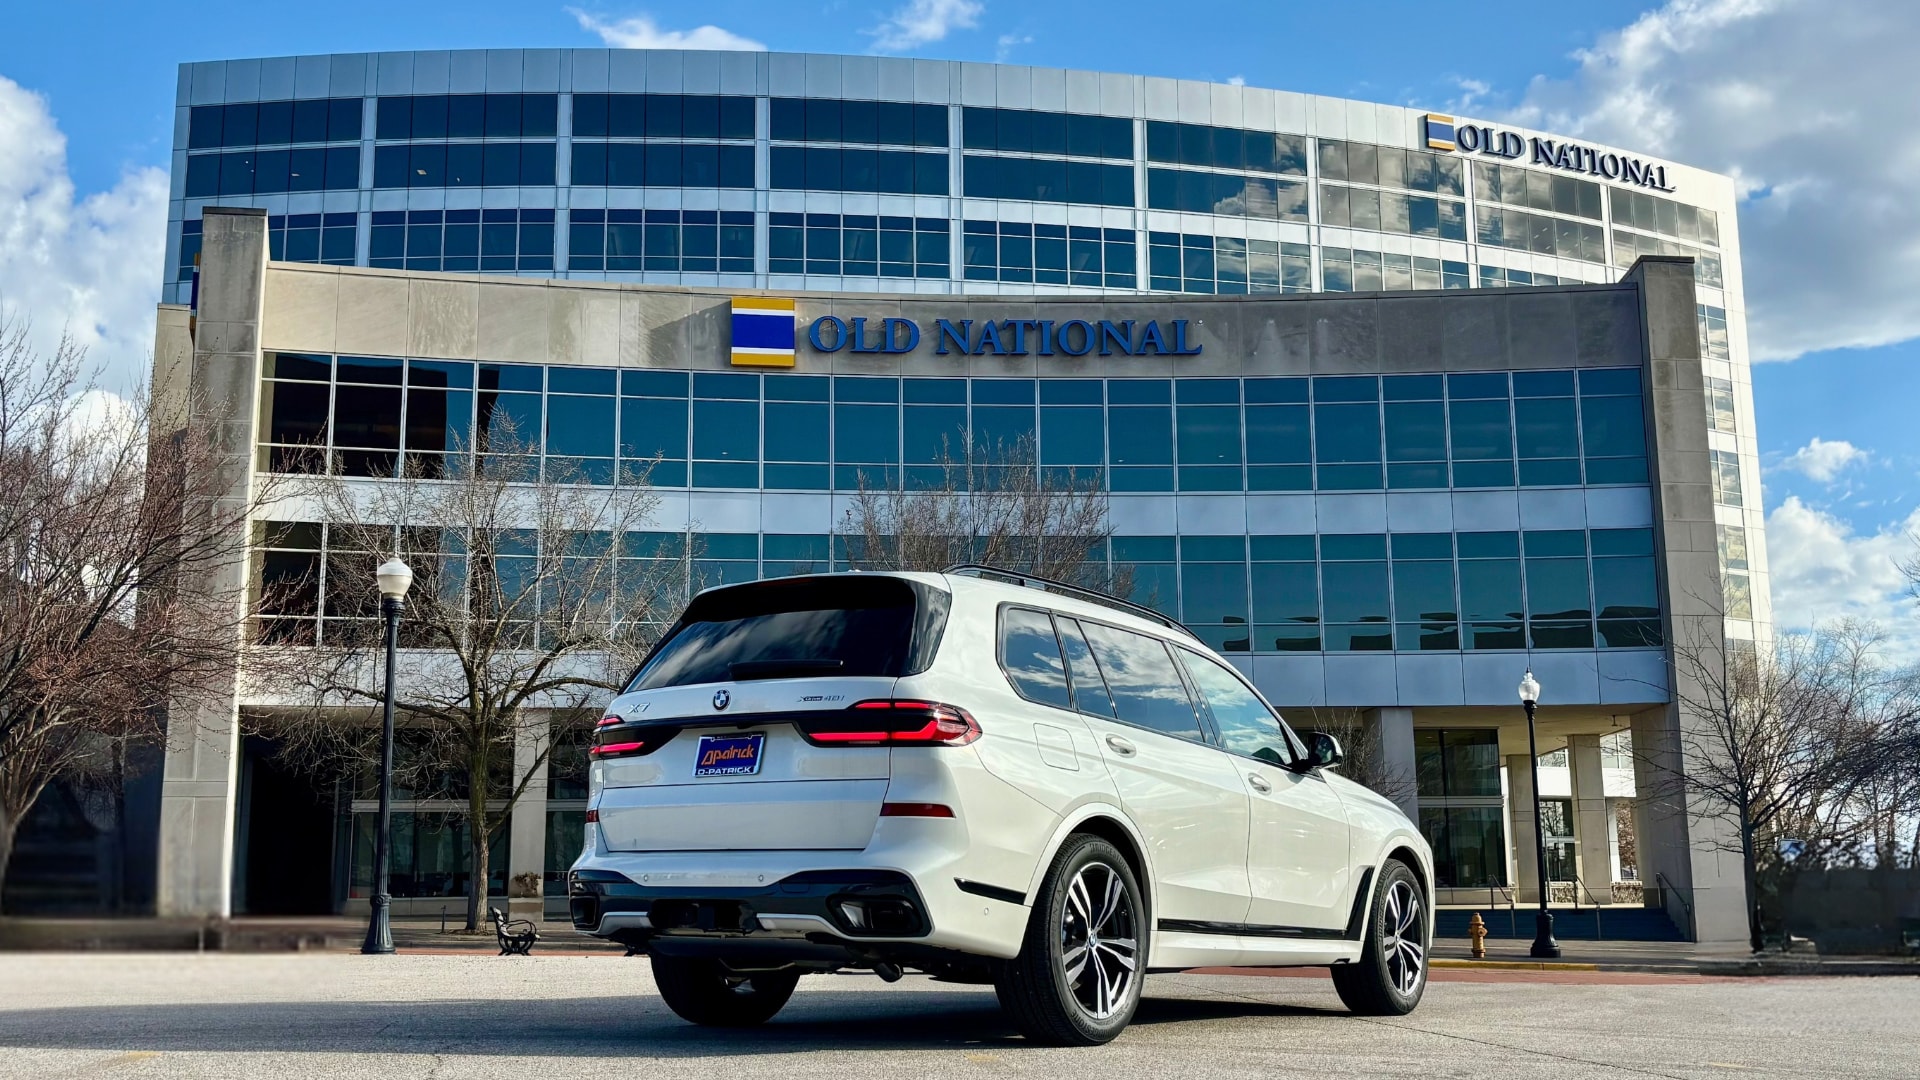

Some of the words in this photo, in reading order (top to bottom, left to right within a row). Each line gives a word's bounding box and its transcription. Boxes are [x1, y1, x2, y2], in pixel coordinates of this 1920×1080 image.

[1457, 124, 1526, 158] OLD
[1529, 136, 1677, 193] NATIONAL
[808, 315, 920, 353] OLD
[935, 318, 1203, 356] NATIONAL
[627, 702, 650, 714] X7
[697, 766, 751, 775] D-PATRICK
